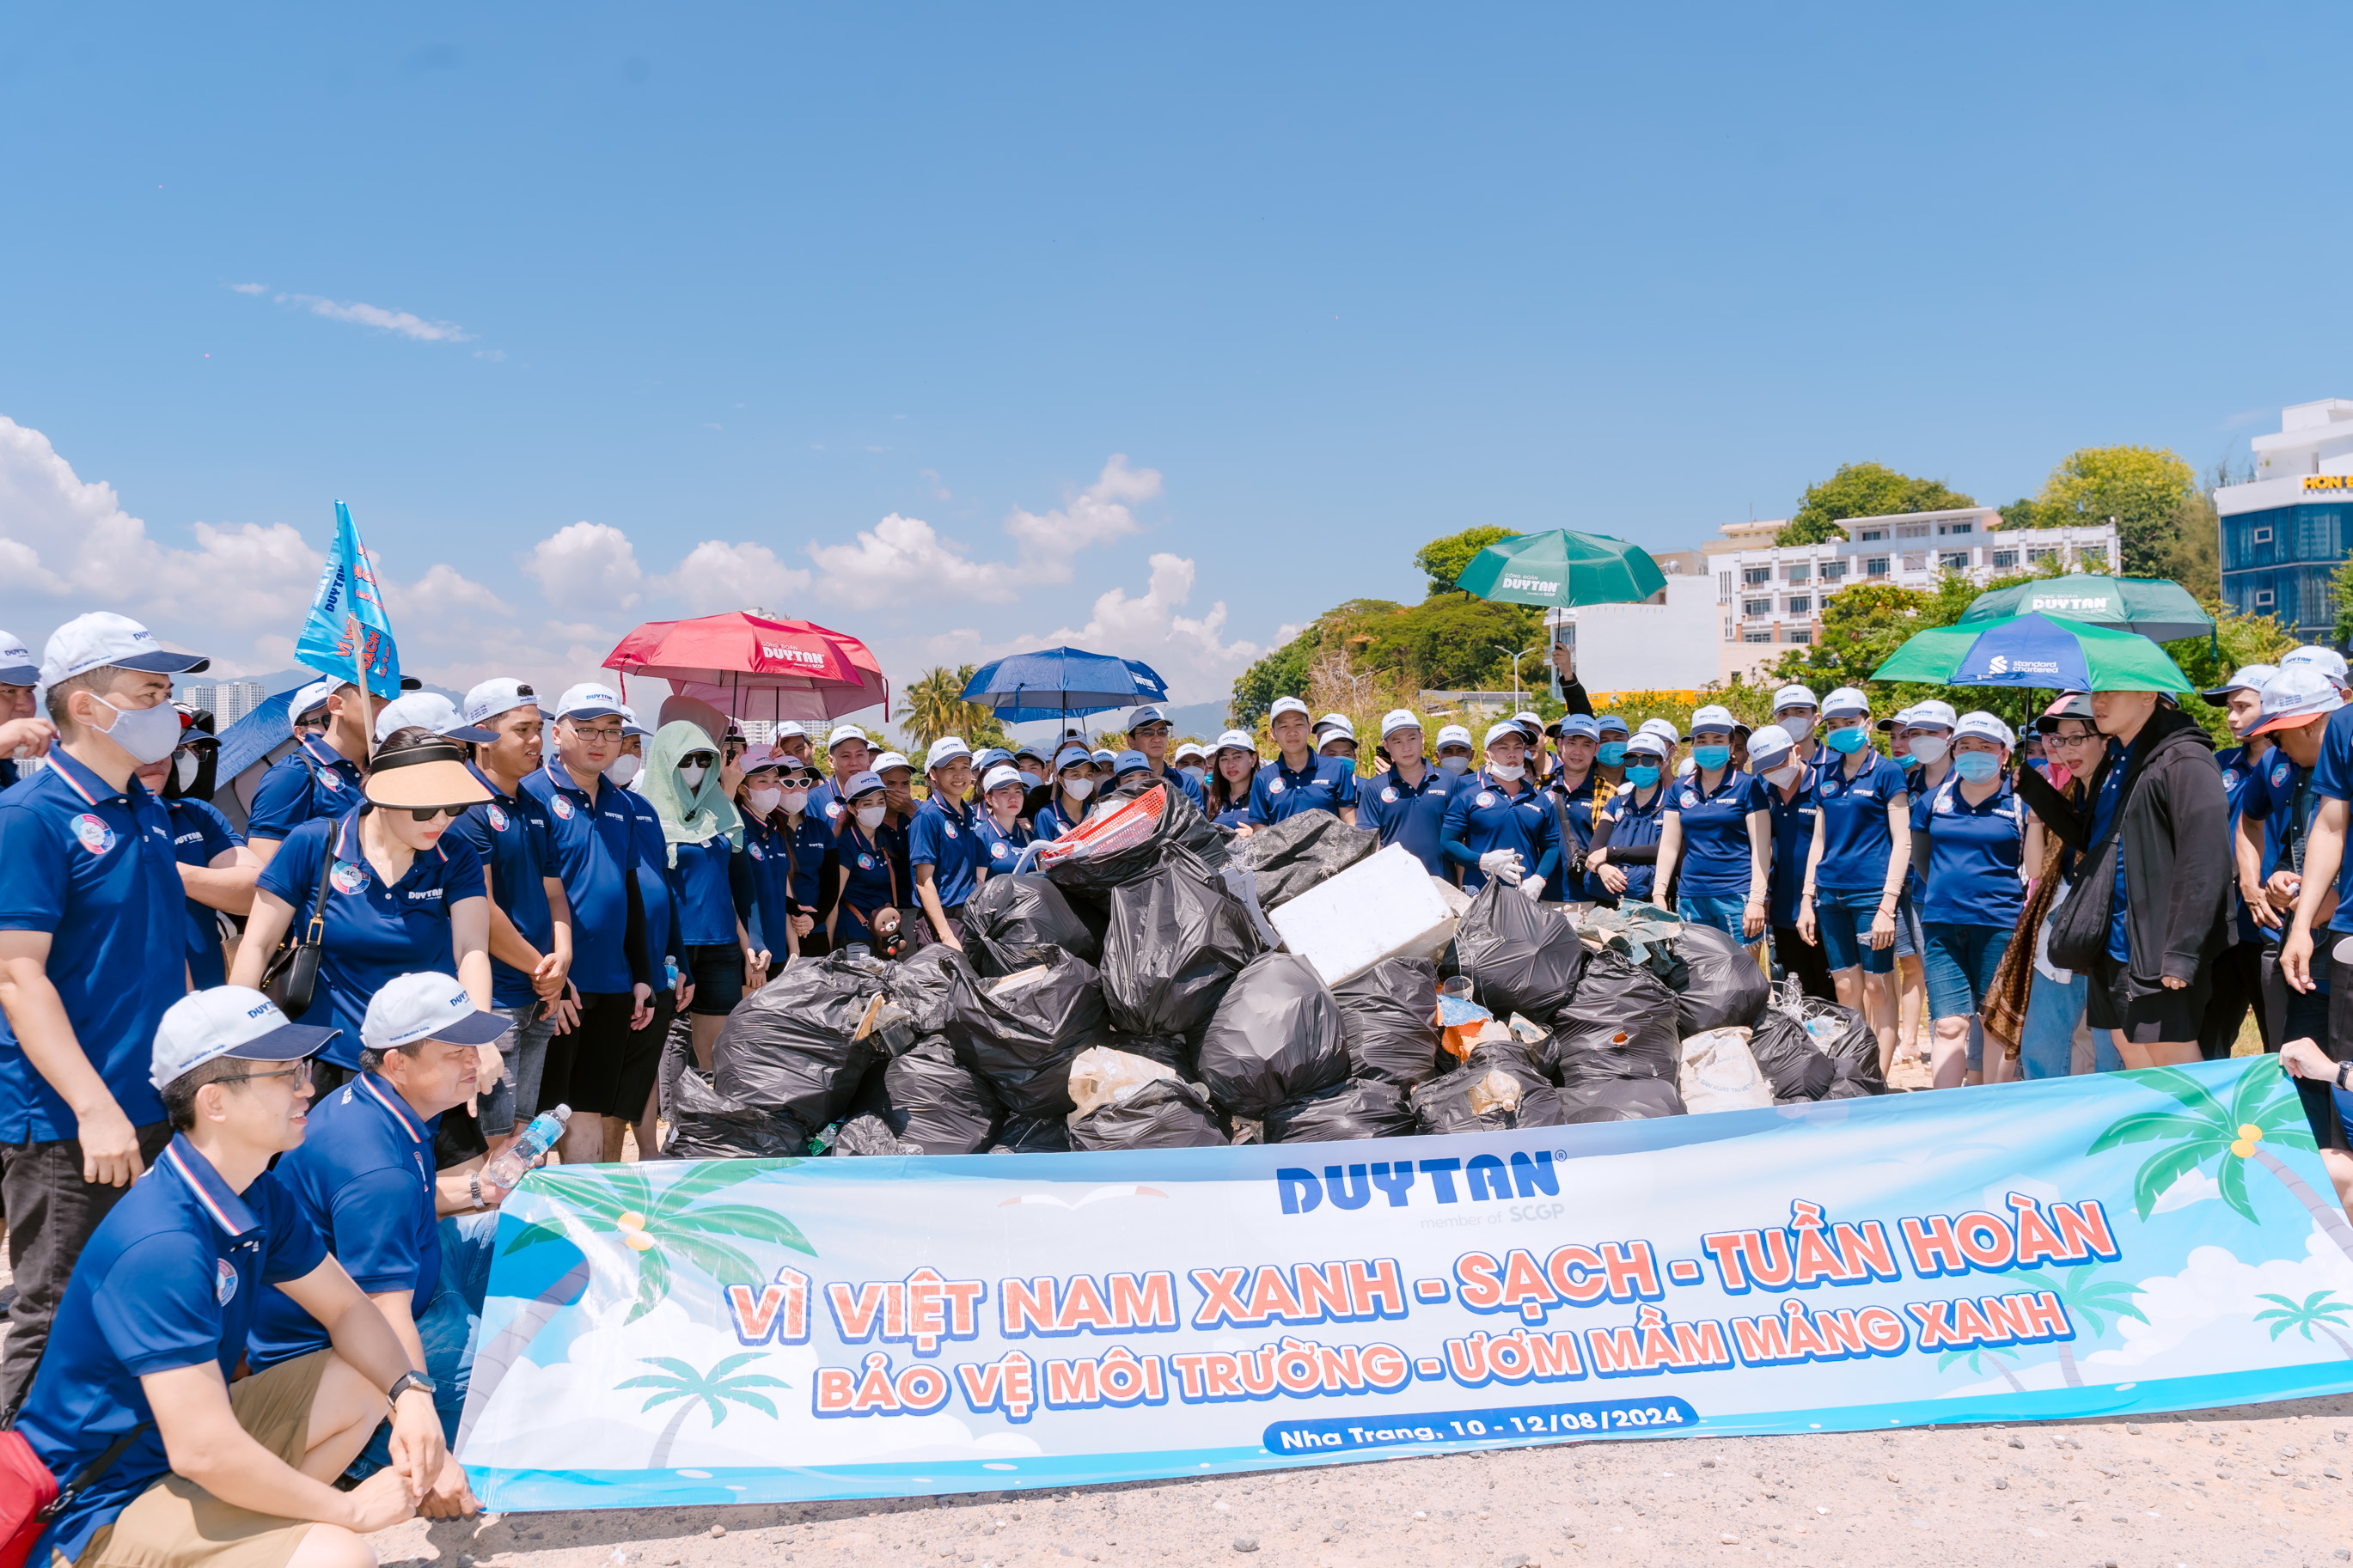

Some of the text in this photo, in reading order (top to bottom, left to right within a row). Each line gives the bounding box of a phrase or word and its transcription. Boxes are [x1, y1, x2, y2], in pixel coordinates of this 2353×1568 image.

[1502, 578, 1558, 593] DUYTAN
[2032, 597, 2107, 610] DUYTAN
[762, 646, 824, 664] DUYTAN
[1421, 1203, 1565, 1229] member of SCGP
[724, 1191, 2122, 1357] VÌ VIỆT NAM XANH - SẠCH - TUẦN HOÀN
[813, 1290, 2076, 1425] BẢO VỆ MÔI TRƯỜNG - ƯƠM MẦM MẢNG XANH
[1280, 1429, 1343, 1449] Nha
[1451, 1419, 1487, 1437] 10
[1509, 1406, 1684, 1434] 12/08/2024
